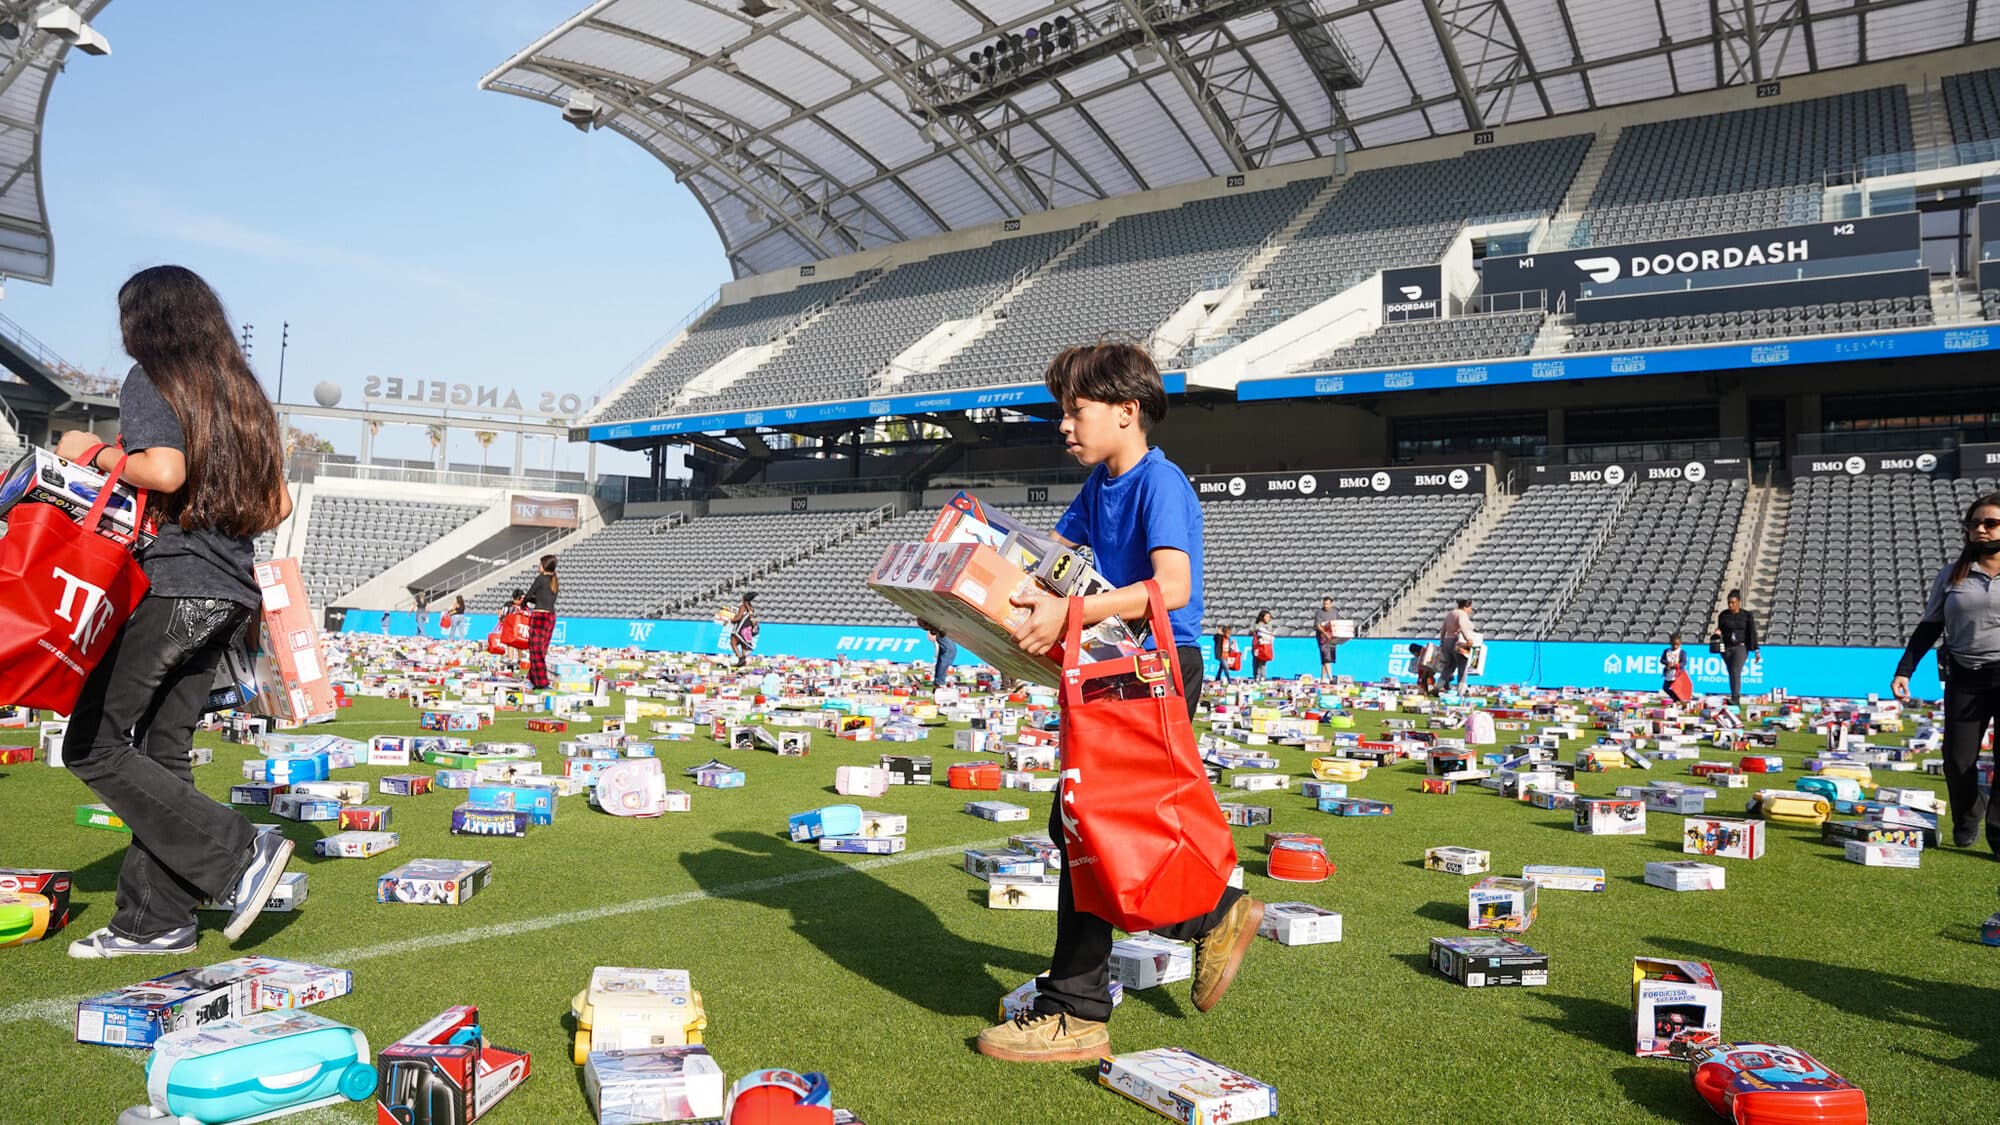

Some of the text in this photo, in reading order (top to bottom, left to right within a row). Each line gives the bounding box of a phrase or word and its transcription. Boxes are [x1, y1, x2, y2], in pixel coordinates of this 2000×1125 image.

[1759, 85, 1778, 97] 212
[1476, 133, 1491, 144] 211
[1228, 177, 1244, 187] 210
[1005, 222, 1020, 231] 209
[1833, 223, 1855, 236] M2
[1519, 257, 1534, 269] M1
[1630, 239, 1809, 277] DOORDASH
[1388, 300, 1436, 313] DOORDASH
[1944, 338, 1989, 351] GAMES
[1751, 351, 1789, 364] GAMES
[1532, 366, 1565, 378] GAMES
[1611, 361, 1646, 373] GAMES
[1384, 377, 1414, 388] GAMES
[1456, 372, 1488, 384] GAMES
[1315, 382, 1344, 393] GAMES
[977, 391, 1024, 403] RITFIT
[1811, 460, 1843, 472] BMO
[1880, 458, 1914, 470] BMO
[1570, 470, 1602, 482] BMO
[1648, 467, 1682, 479] BMO
[1268, 480, 1296, 491] BMO
[1339, 477, 1369, 488] BMO
[1415, 474, 1445, 486] BMO
[1199, 482, 1227, 493] BMO
[1030, 490, 1046, 501] 110
[792, 500, 807, 511] 109
[628, 621, 655, 641] TKF
[836, 637, 920, 652] RITFIT
[461, 818, 516, 835] GALAXY
[1643, 991, 1664, 999] FORD
